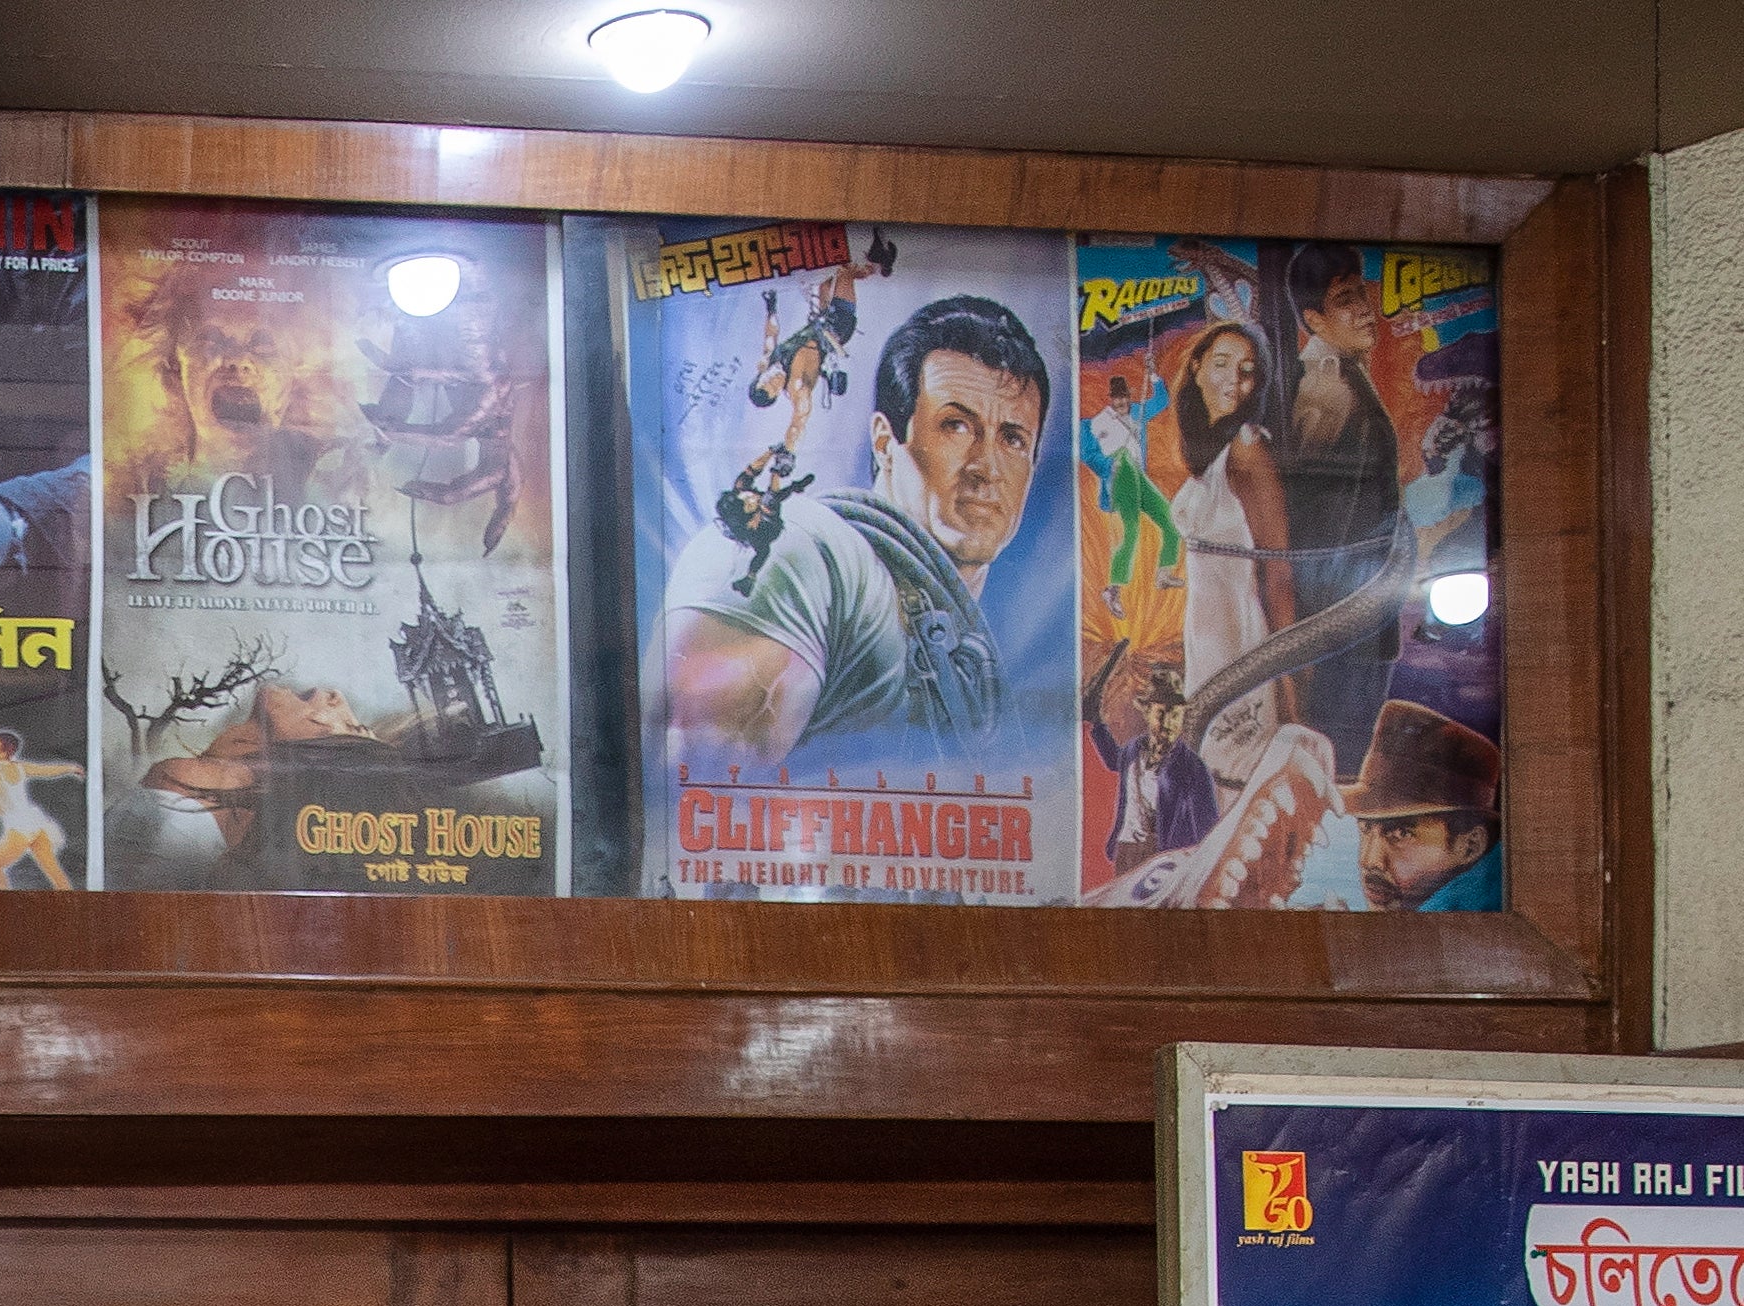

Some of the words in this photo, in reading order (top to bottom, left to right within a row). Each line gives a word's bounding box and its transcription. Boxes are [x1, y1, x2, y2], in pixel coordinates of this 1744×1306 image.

[4, 255, 28, 270] FOR
[30, 257, 40, 271] A
[238, 277, 275, 289] MARK
[1079, 274, 1199, 334] RAIDERS
[209, 471, 369, 538] Ghost
[127, 492, 375, 589] House
[296, 804, 419, 855] GHOST
[424, 808, 542, 859] HOUSE
[677, 788, 1034, 862] CLIFFHANGER
[678, 859, 724, 885] THE
[737, 860, 830, 887] HEIGHT
[842, 864, 871, 889] OF
[884, 866, 1036, 896] ADVENTURE.
[1537, 1160, 1621, 1195] YASH
[1633, 1162, 1694, 1197] RAJ
[1705, 1164, 1744, 1198] FIL
